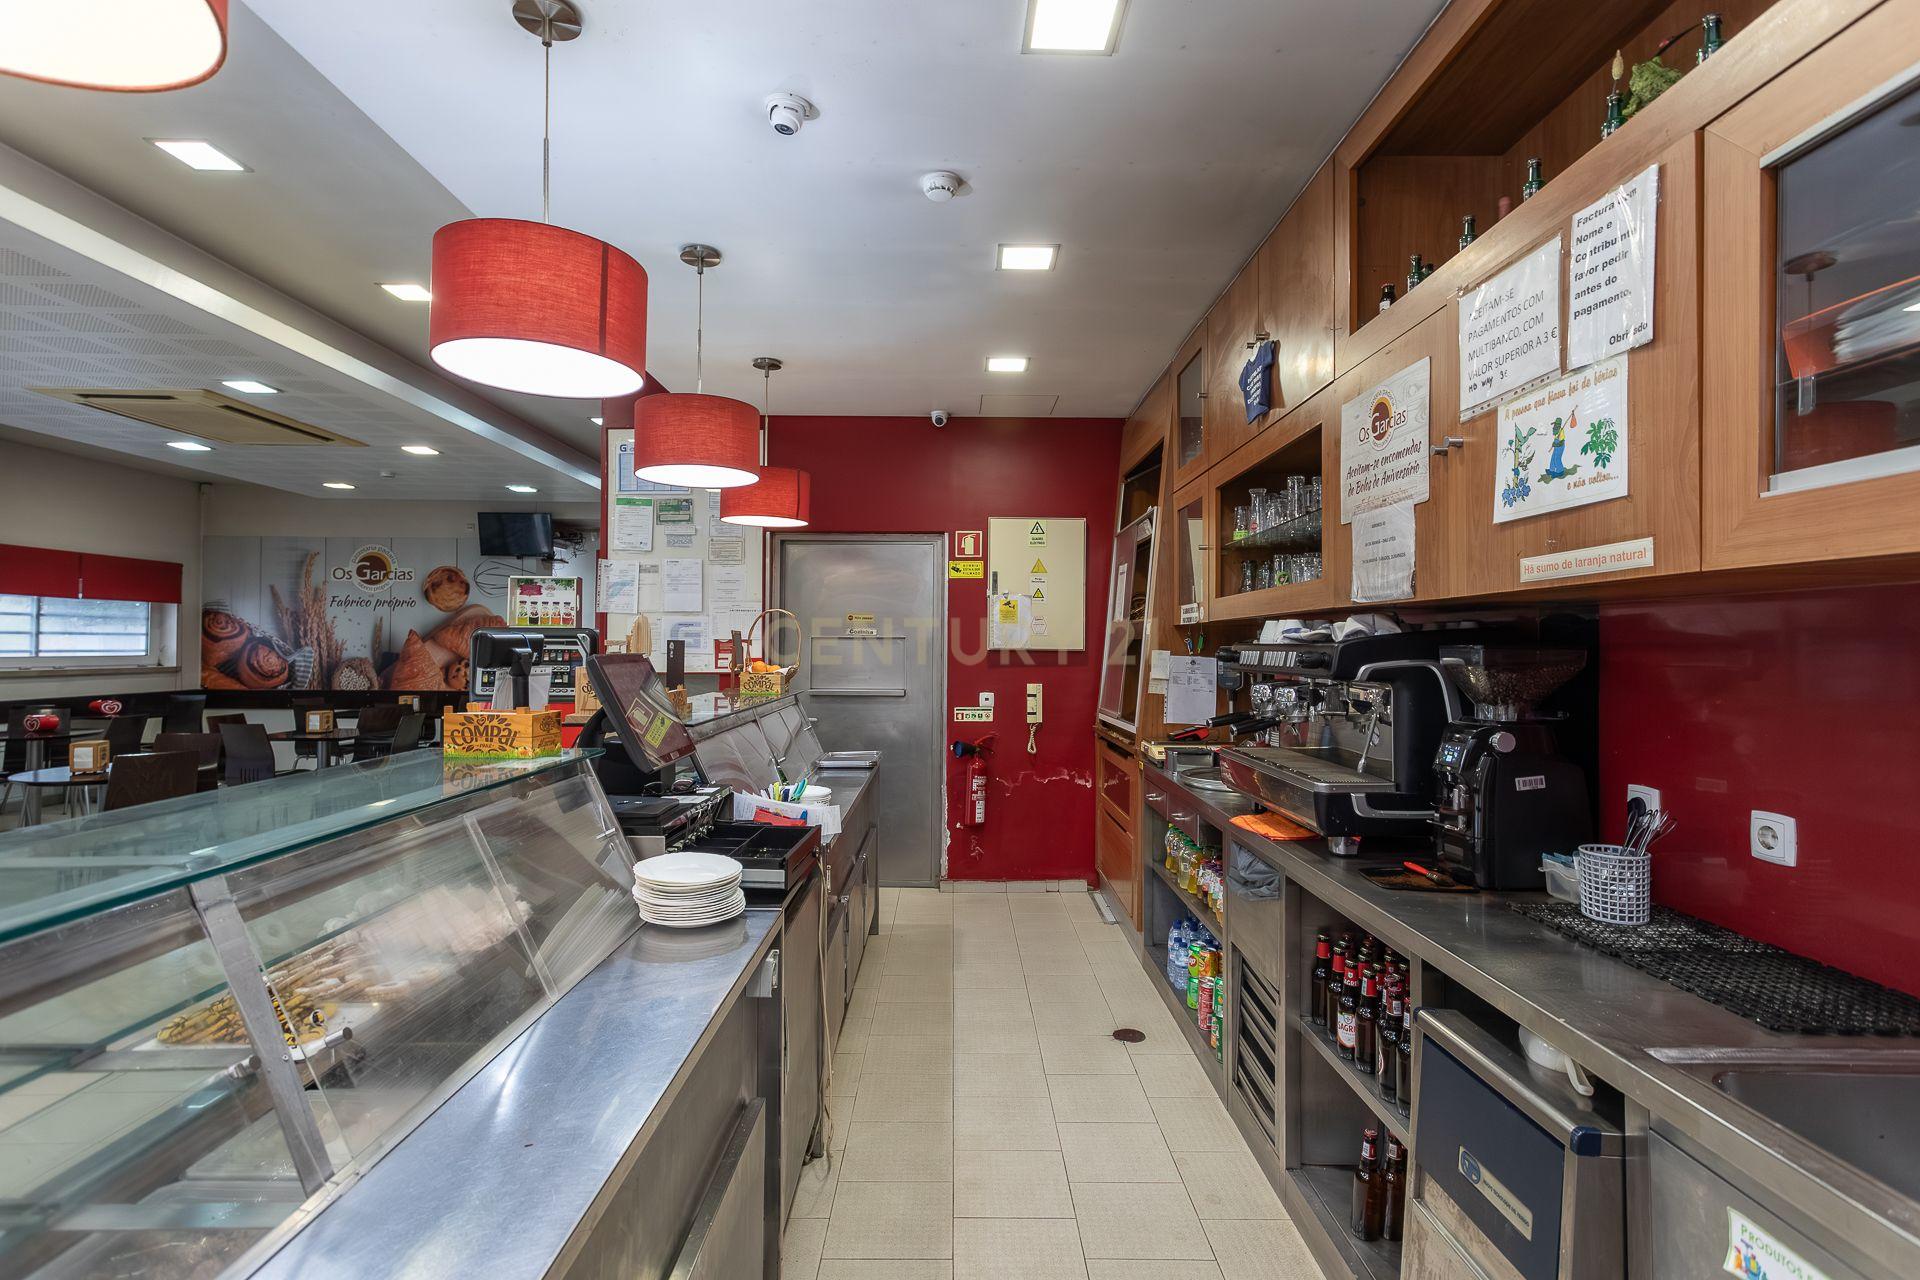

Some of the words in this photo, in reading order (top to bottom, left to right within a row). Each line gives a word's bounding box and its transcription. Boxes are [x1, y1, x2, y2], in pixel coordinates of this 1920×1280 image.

[1576, 201, 1615, 228] Factura
[1575, 225, 1603, 246] Nome
[1606, 220, 1613, 230] e
[1574, 263, 1599, 282] favor
[1601, 249, 1629, 271] pedir
[1574, 282, 1602, 300] antes
[1604, 275, 1618, 288] do
[1467, 303, 1522, 343] PAGAMENTOS
[1523, 289, 1544, 311] COM
[1523, 312, 1544, 332] COM
[1609, 321, 1648, 346] Obriado
[1467, 361, 1493, 381] VALOR
[1495, 340, 1534, 369] SUPERIOR
[1535, 336, 1542, 348] A
[1543, 331, 1549, 344] 3
[1550, 326, 1558, 339] €
[1533, 397, 1546, 413] que
[1568, 383, 1579, 397] foi
[1580, 376, 1592, 389] de
[1593, 367, 1618, 386] férias
[1358, 427, 1370, 443] Os
[1371, 409, 1407, 438] Garcias
[1346, 458, 1380, 480] Aceitam-se
[1380, 438, 1422, 466] encomendas
[1347, 482, 1355, 498] de
[1355, 477, 1372, 495] Bolos
[1372, 473, 1381, 488] de
[1380, 460, 1420, 487] Aniversário
[1566, 479, 1571, 490] e
[1572, 476, 1586, 490] não
[332, 567, 353, 580] Os
[355, 561, 413, 581] Garcias
[1523, 564, 1535, 575] Há
[1536, 562, 1559, 574] sumo
[1561, 559, 1572, 570] de
[1575, 553, 1607, 568] laranja
[1609, 547, 1647, 564] natural
[329, 594, 372, 608] Fabrico
[373, 596, 417, 612] próprio
[849, 628, 874, 636] Cozinha
[1740, 1223, 1804, 1277] PRODUTOS
